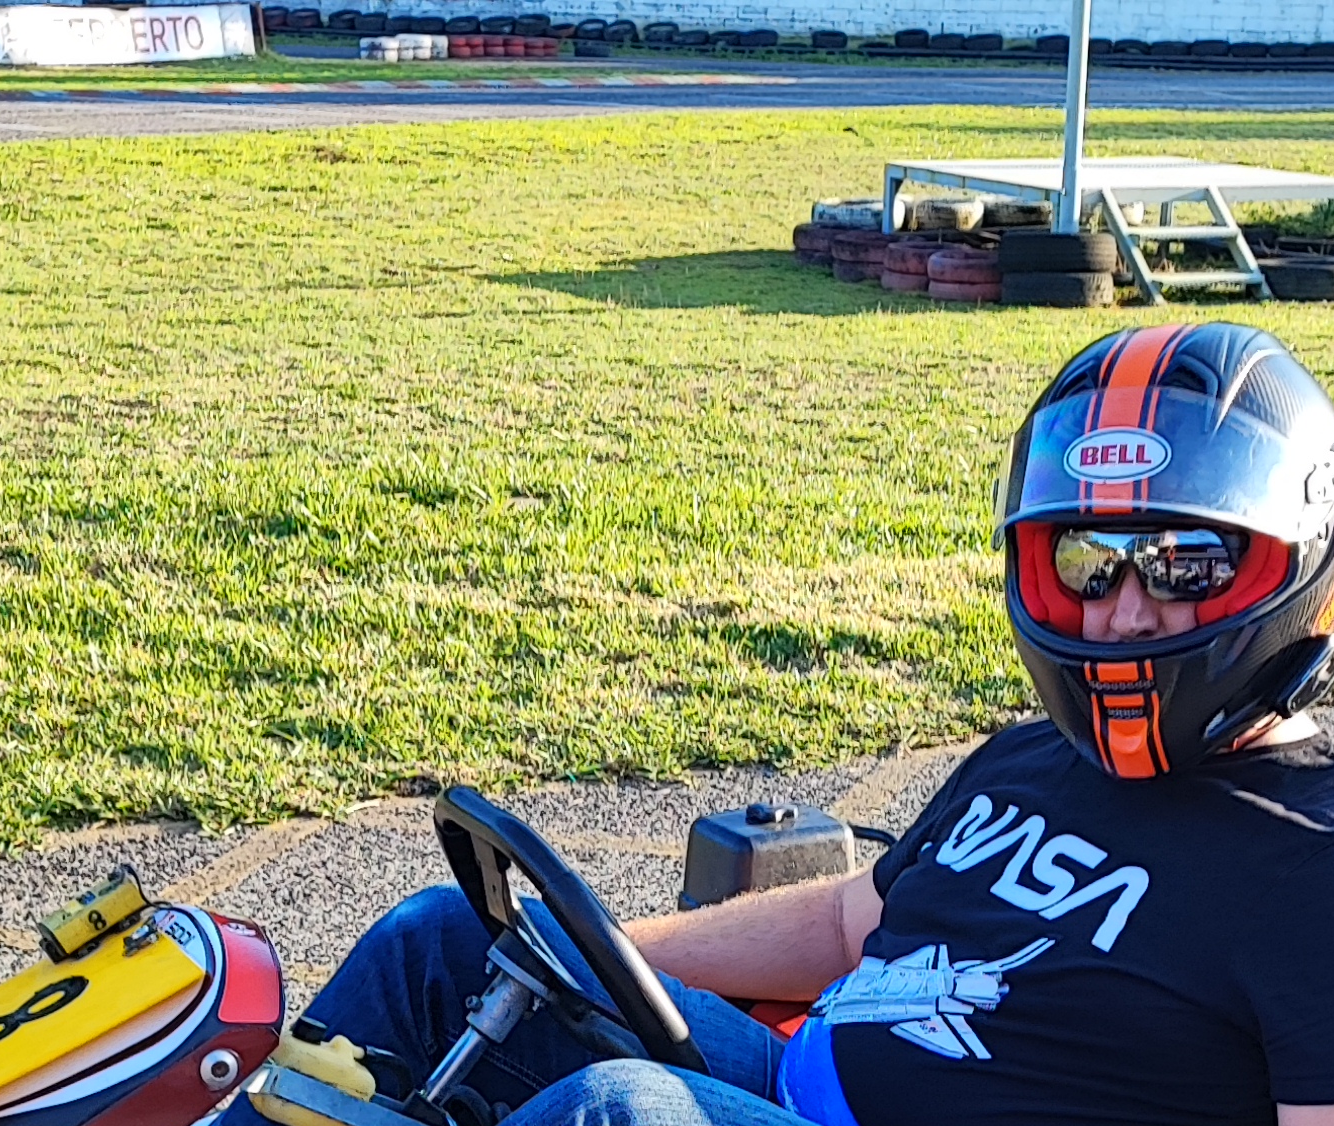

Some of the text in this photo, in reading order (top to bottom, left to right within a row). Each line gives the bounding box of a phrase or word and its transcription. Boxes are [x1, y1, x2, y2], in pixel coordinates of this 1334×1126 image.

[1079, 443, 1152, 467] BELL
[935, 794, 1150, 953] NASA
[88, 909, 106, 931] 8
